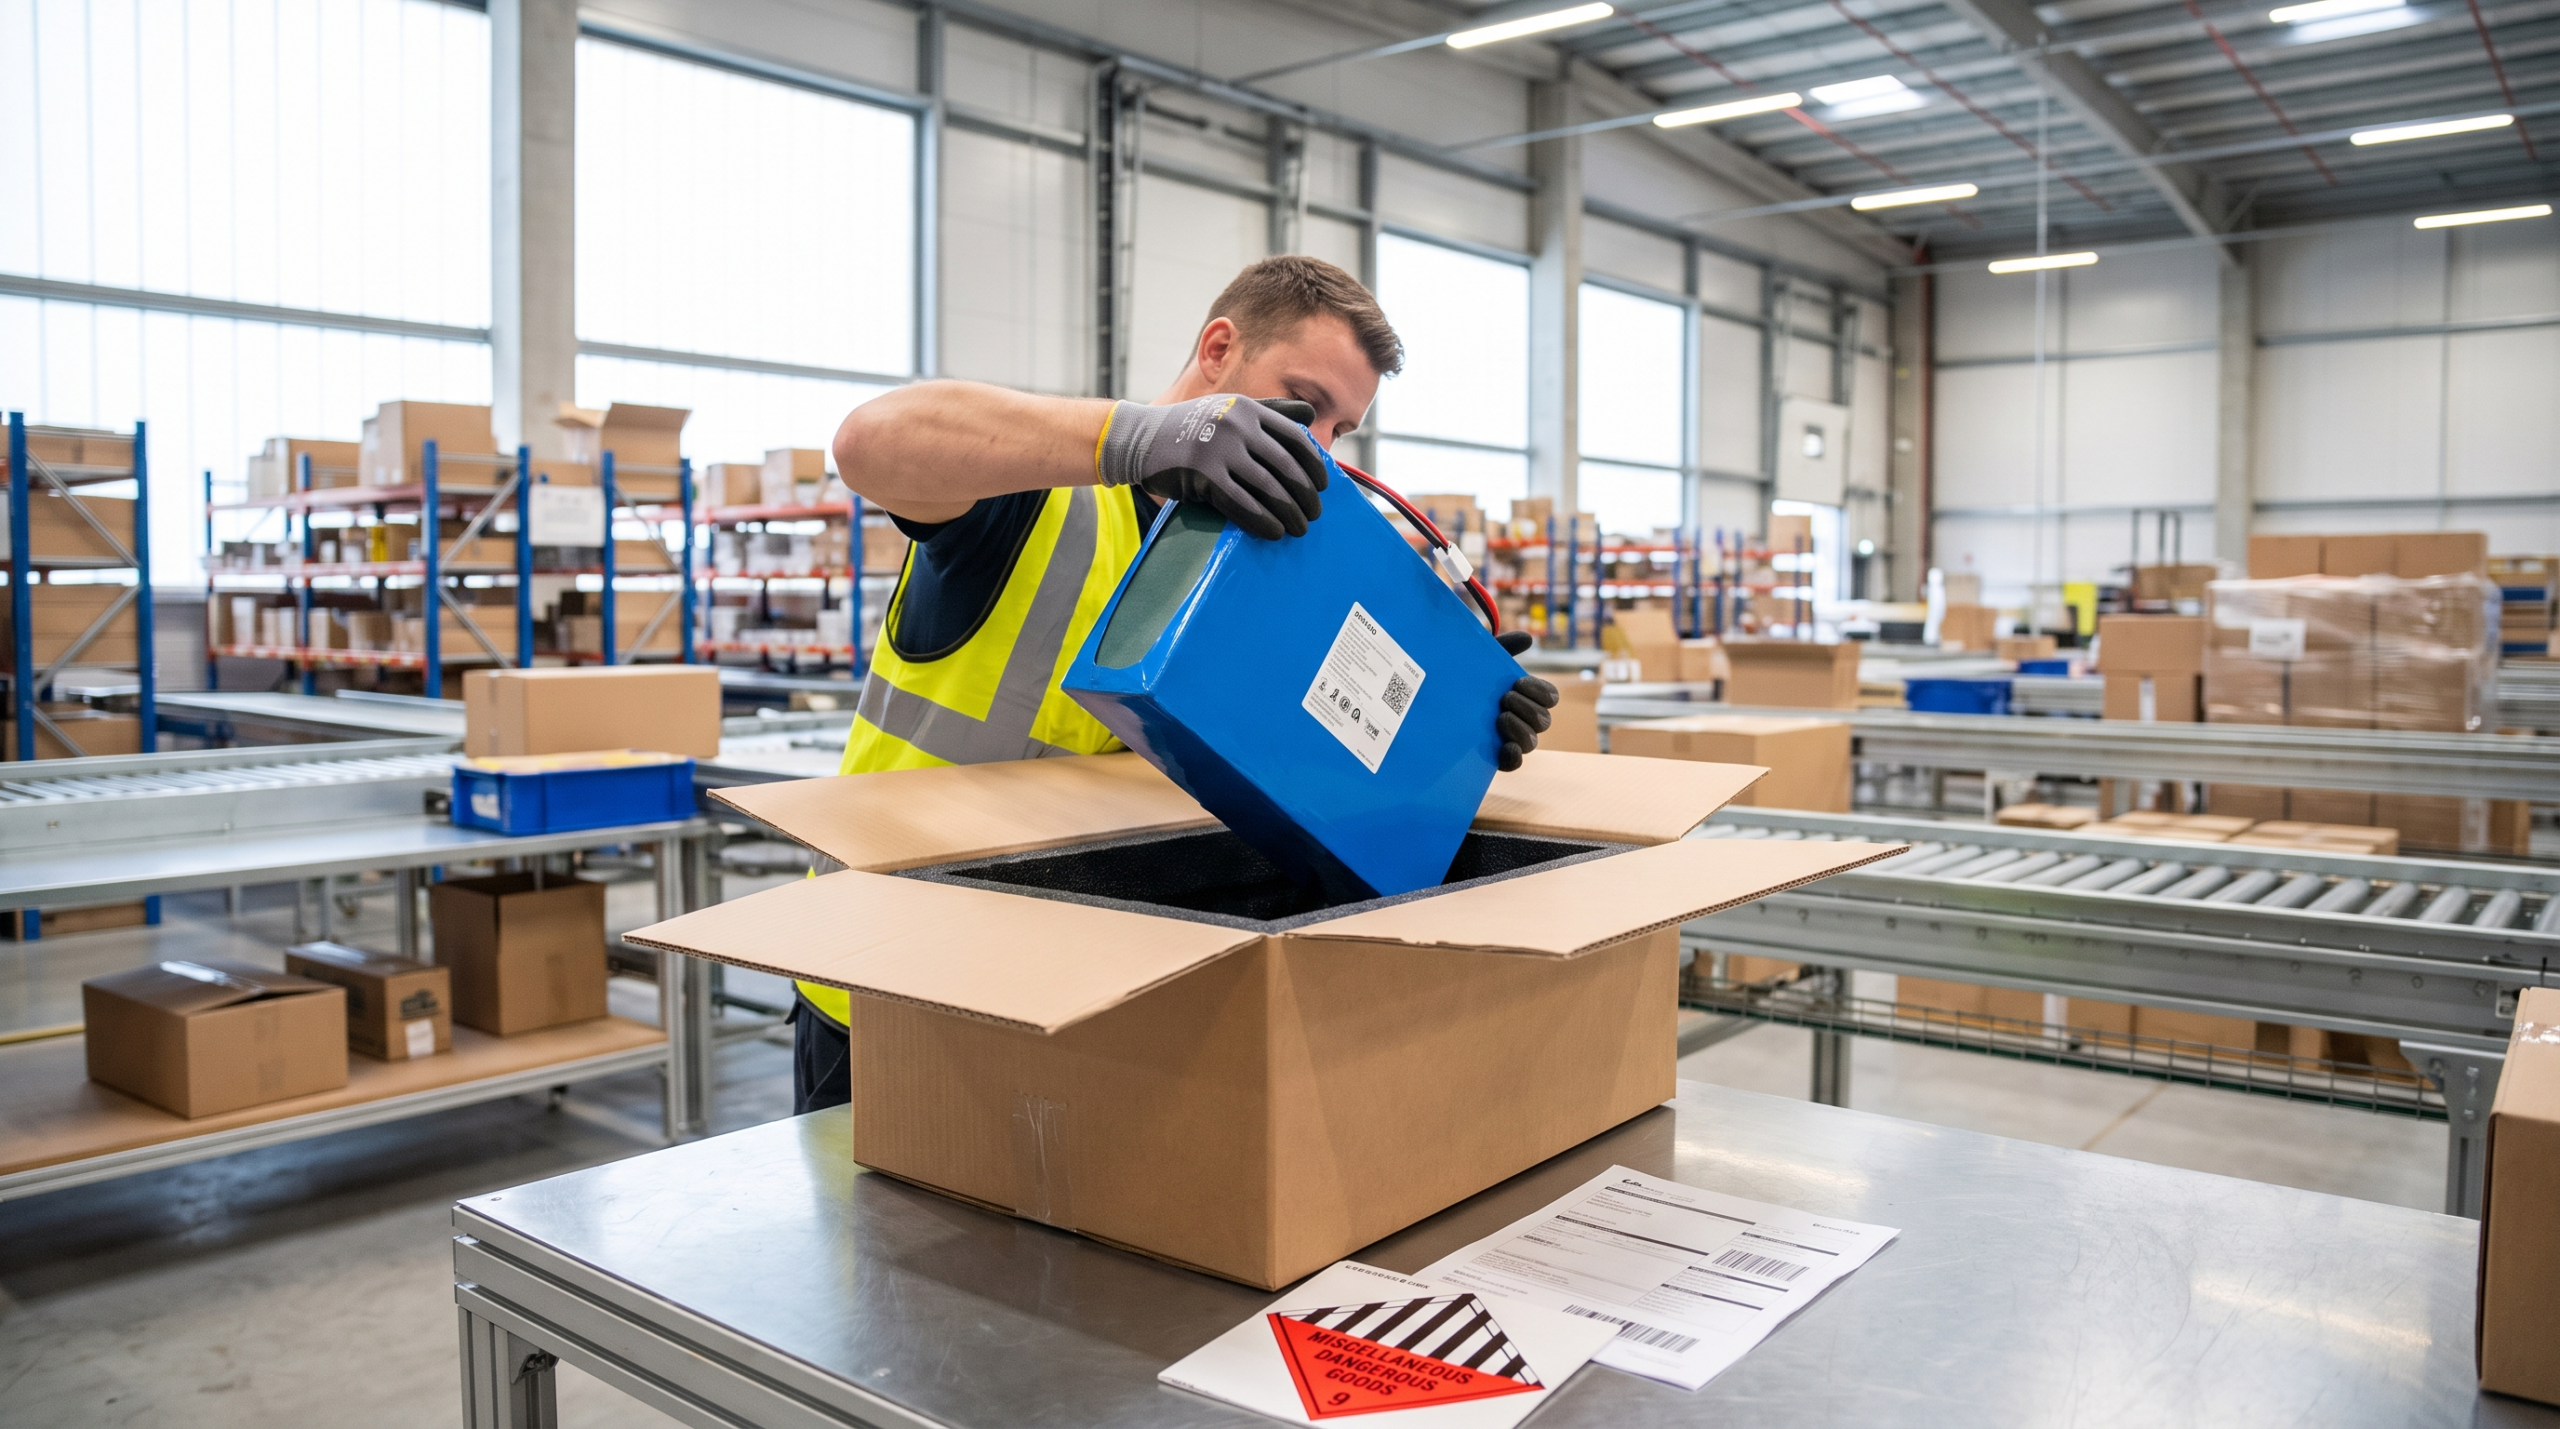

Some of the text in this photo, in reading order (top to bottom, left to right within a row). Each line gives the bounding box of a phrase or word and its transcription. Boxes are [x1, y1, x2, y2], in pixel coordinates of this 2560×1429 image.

[1307, 1331, 1474, 1385] MISCELLANEOUS
[1314, 1349, 1439, 1392] DANGEROUS
[1325, 1368, 1398, 1396] GOODS
[1327, 1391, 1351, 1406] 9
